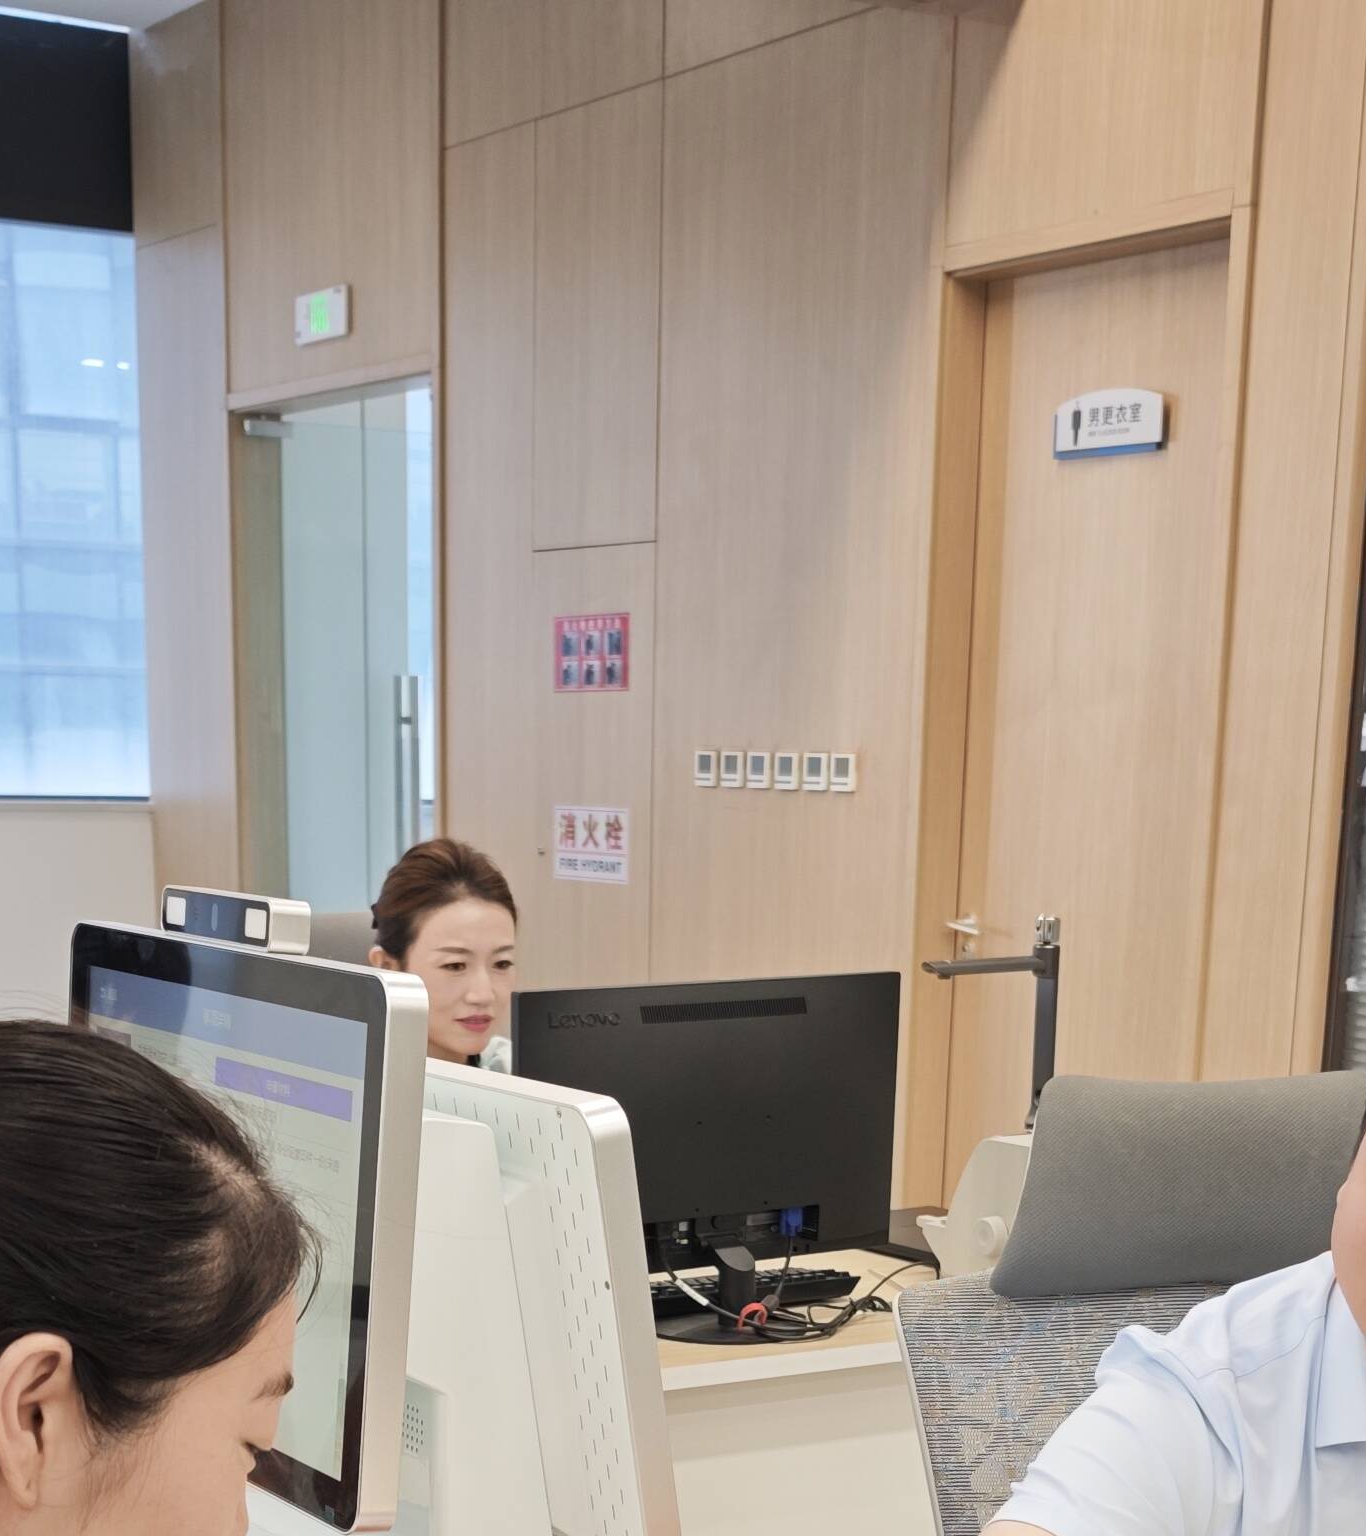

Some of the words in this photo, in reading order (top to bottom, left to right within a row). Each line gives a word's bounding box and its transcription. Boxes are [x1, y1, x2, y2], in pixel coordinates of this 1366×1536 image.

[1088, 403, 1142, 427] 男更衣室
[558, 812, 623, 850] 消火栓
[559, 857, 578, 871] FIRE
[580, 859, 622, 874] HYDRANT
